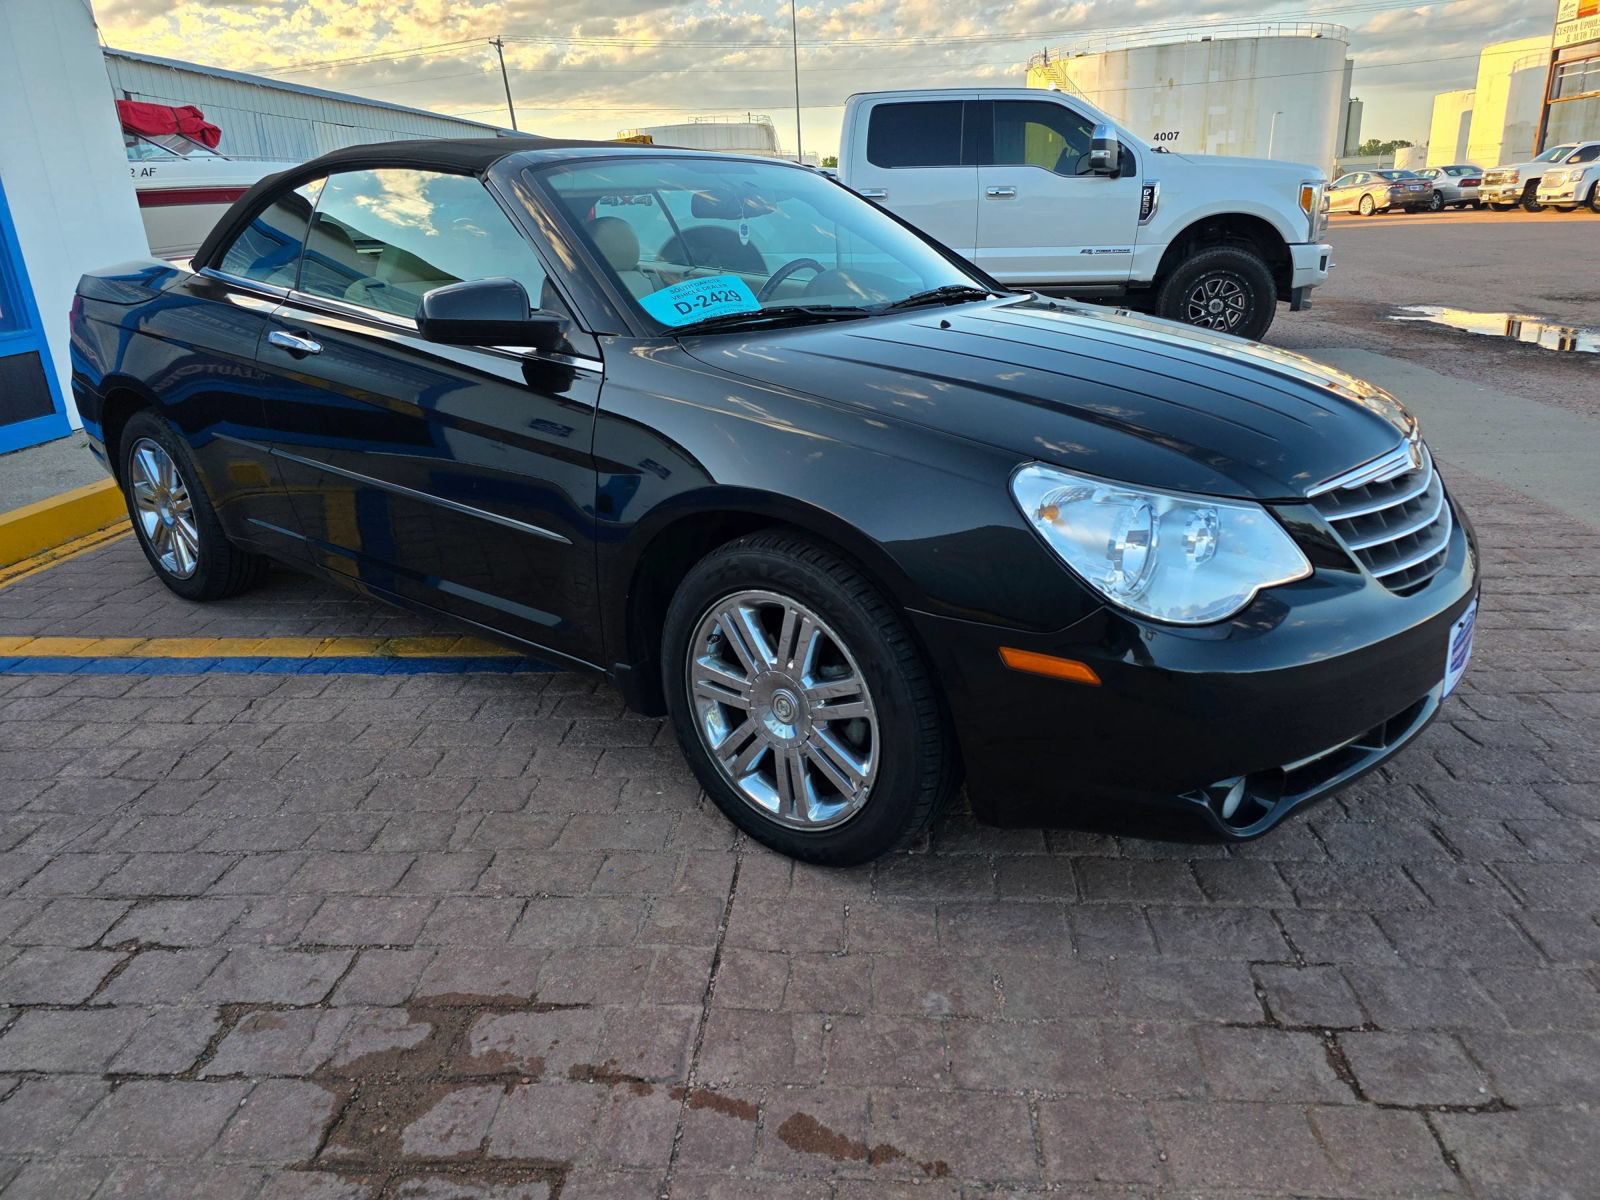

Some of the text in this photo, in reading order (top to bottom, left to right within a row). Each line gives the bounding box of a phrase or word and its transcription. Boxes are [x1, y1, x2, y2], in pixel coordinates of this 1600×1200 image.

[1153, 131, 1180, 141] 4007
[141, 168, 157, 177] AF
[670, 278, 721, 294] SOUTH DAKOTA
[671, 283, 728, 301] VEHICLE DEALER
[674, 289, 742, 315] D-2429
